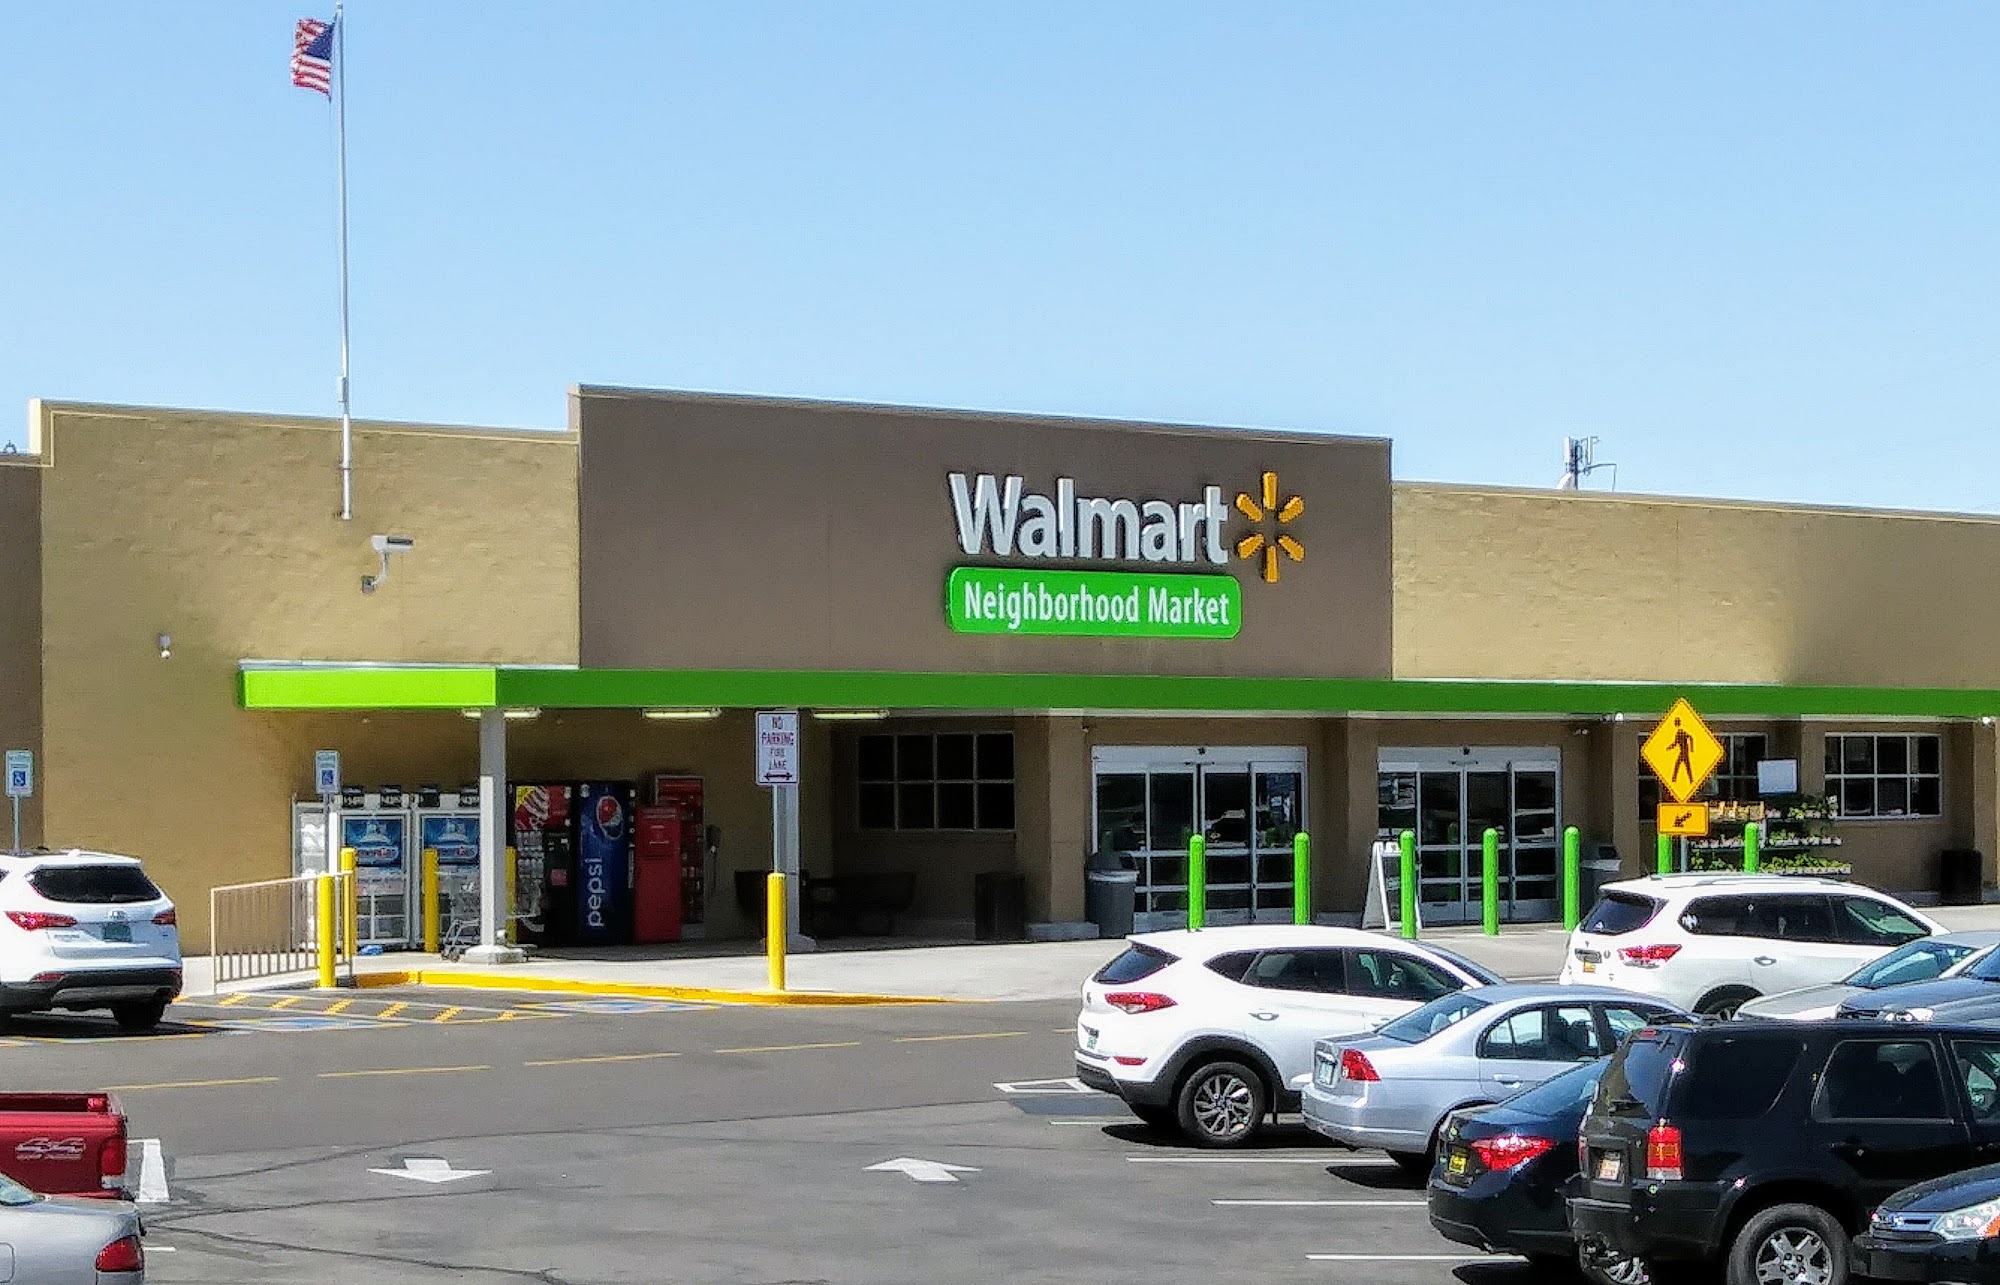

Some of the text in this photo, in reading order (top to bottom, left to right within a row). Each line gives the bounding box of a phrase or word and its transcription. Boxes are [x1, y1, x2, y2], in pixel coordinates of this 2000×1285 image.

[948, 472, 1230, 564] Walmart
[964, 581, 1230, 629] Neighborhood Market
[761, 732, 794, 746] PARKING
[772, 716, 783, 729] NO
[585, 857, 606, 928] pepsi
